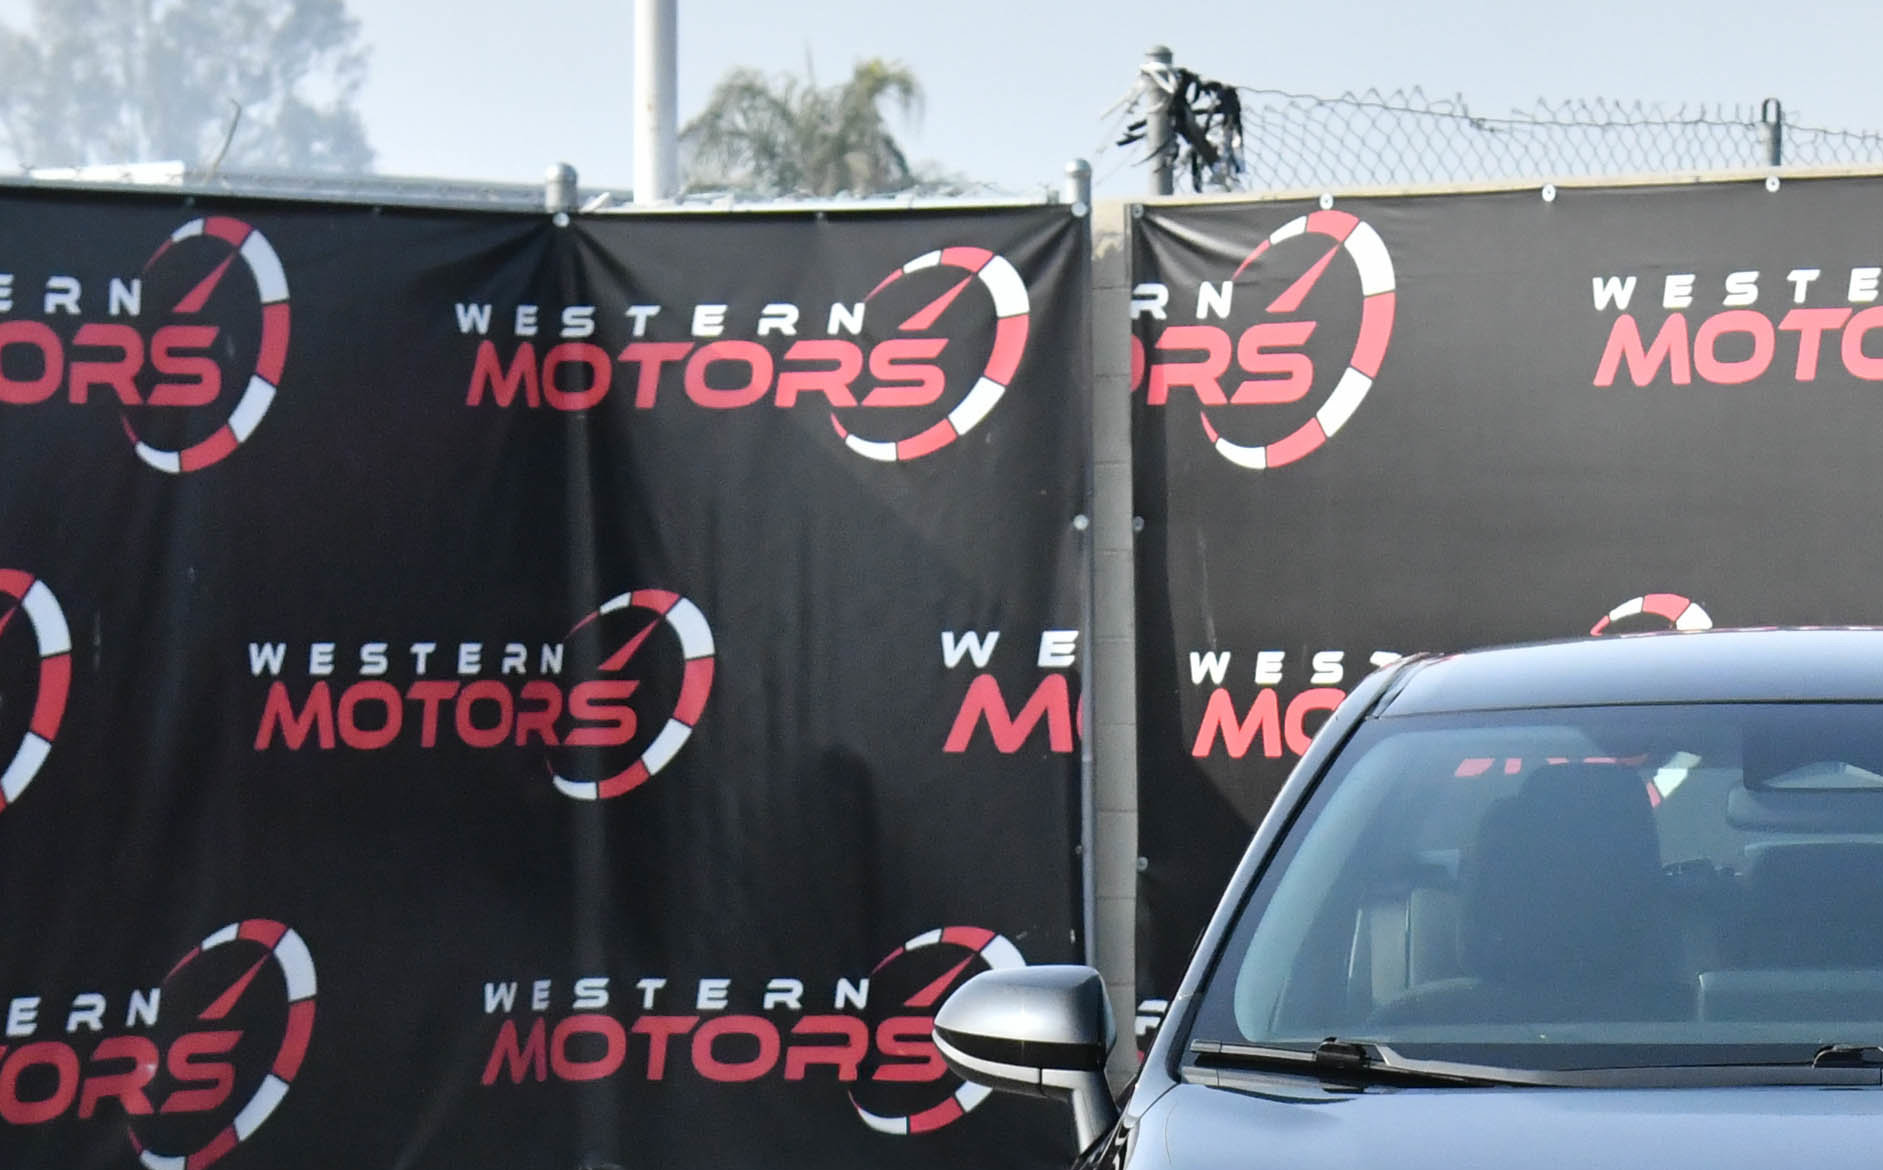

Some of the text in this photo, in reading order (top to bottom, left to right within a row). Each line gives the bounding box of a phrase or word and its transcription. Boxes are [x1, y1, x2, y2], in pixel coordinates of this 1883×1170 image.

[457, 301, 867, 338] WESTERN
[0, 319, 222, 407] ORS
[465, 337, 950, 412] MOTORS
[250, 643, 563, 675] WESTERN
[255, 679, 641, 751] MOTORS
[485, 978, 869, 1013] WESTERN
[0, 1030, 244, 1125] ORS
[481, 1014, 951, 1085] MOTORS
